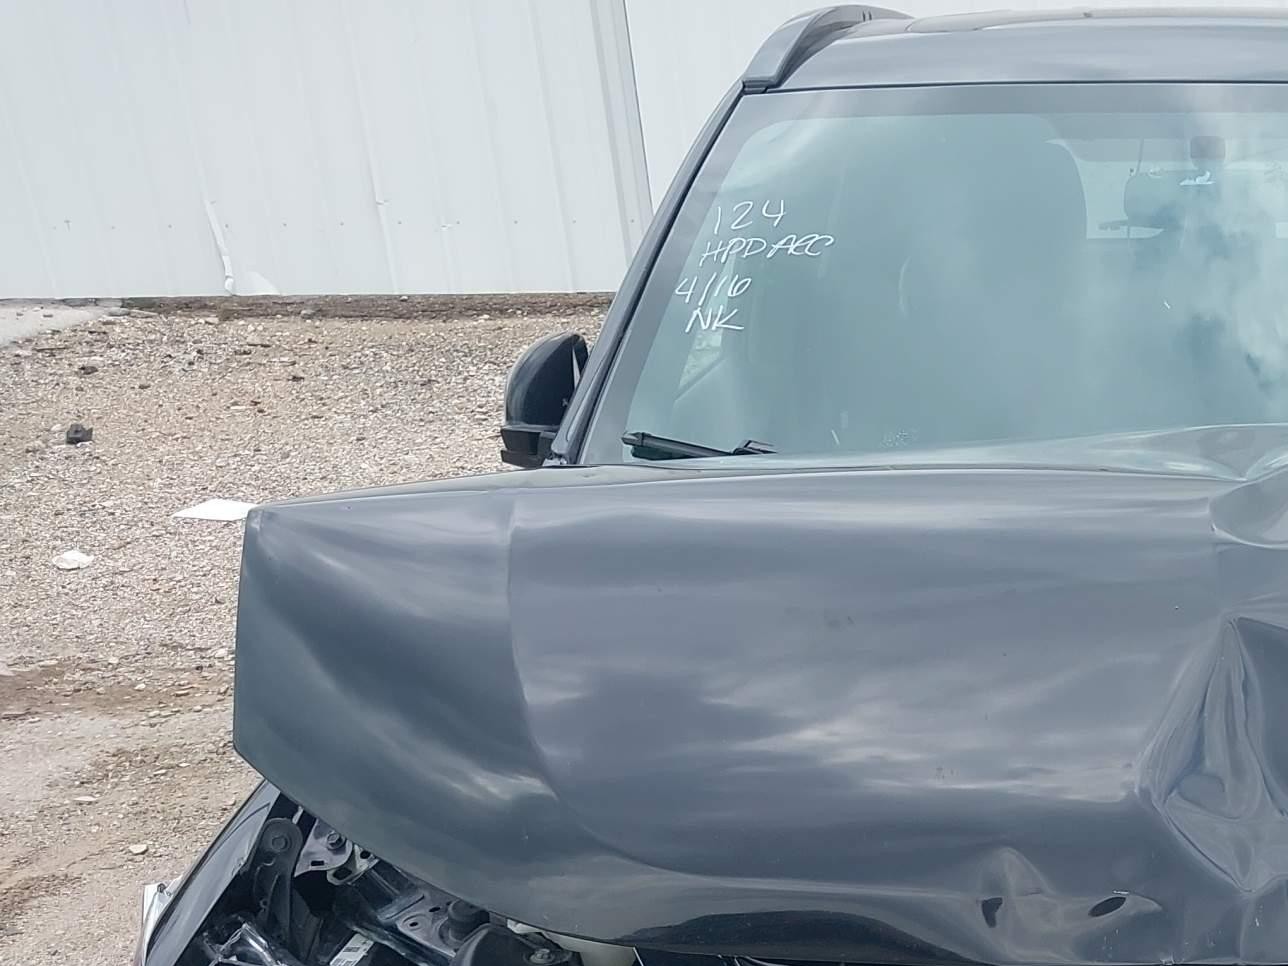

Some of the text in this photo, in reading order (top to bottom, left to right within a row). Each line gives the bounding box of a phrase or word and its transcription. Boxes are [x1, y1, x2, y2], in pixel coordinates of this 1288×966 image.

[713, 199, 786, 235] 124
[674, 271, 752, 306] 4/16
[684, 305, 745, 334] NK
